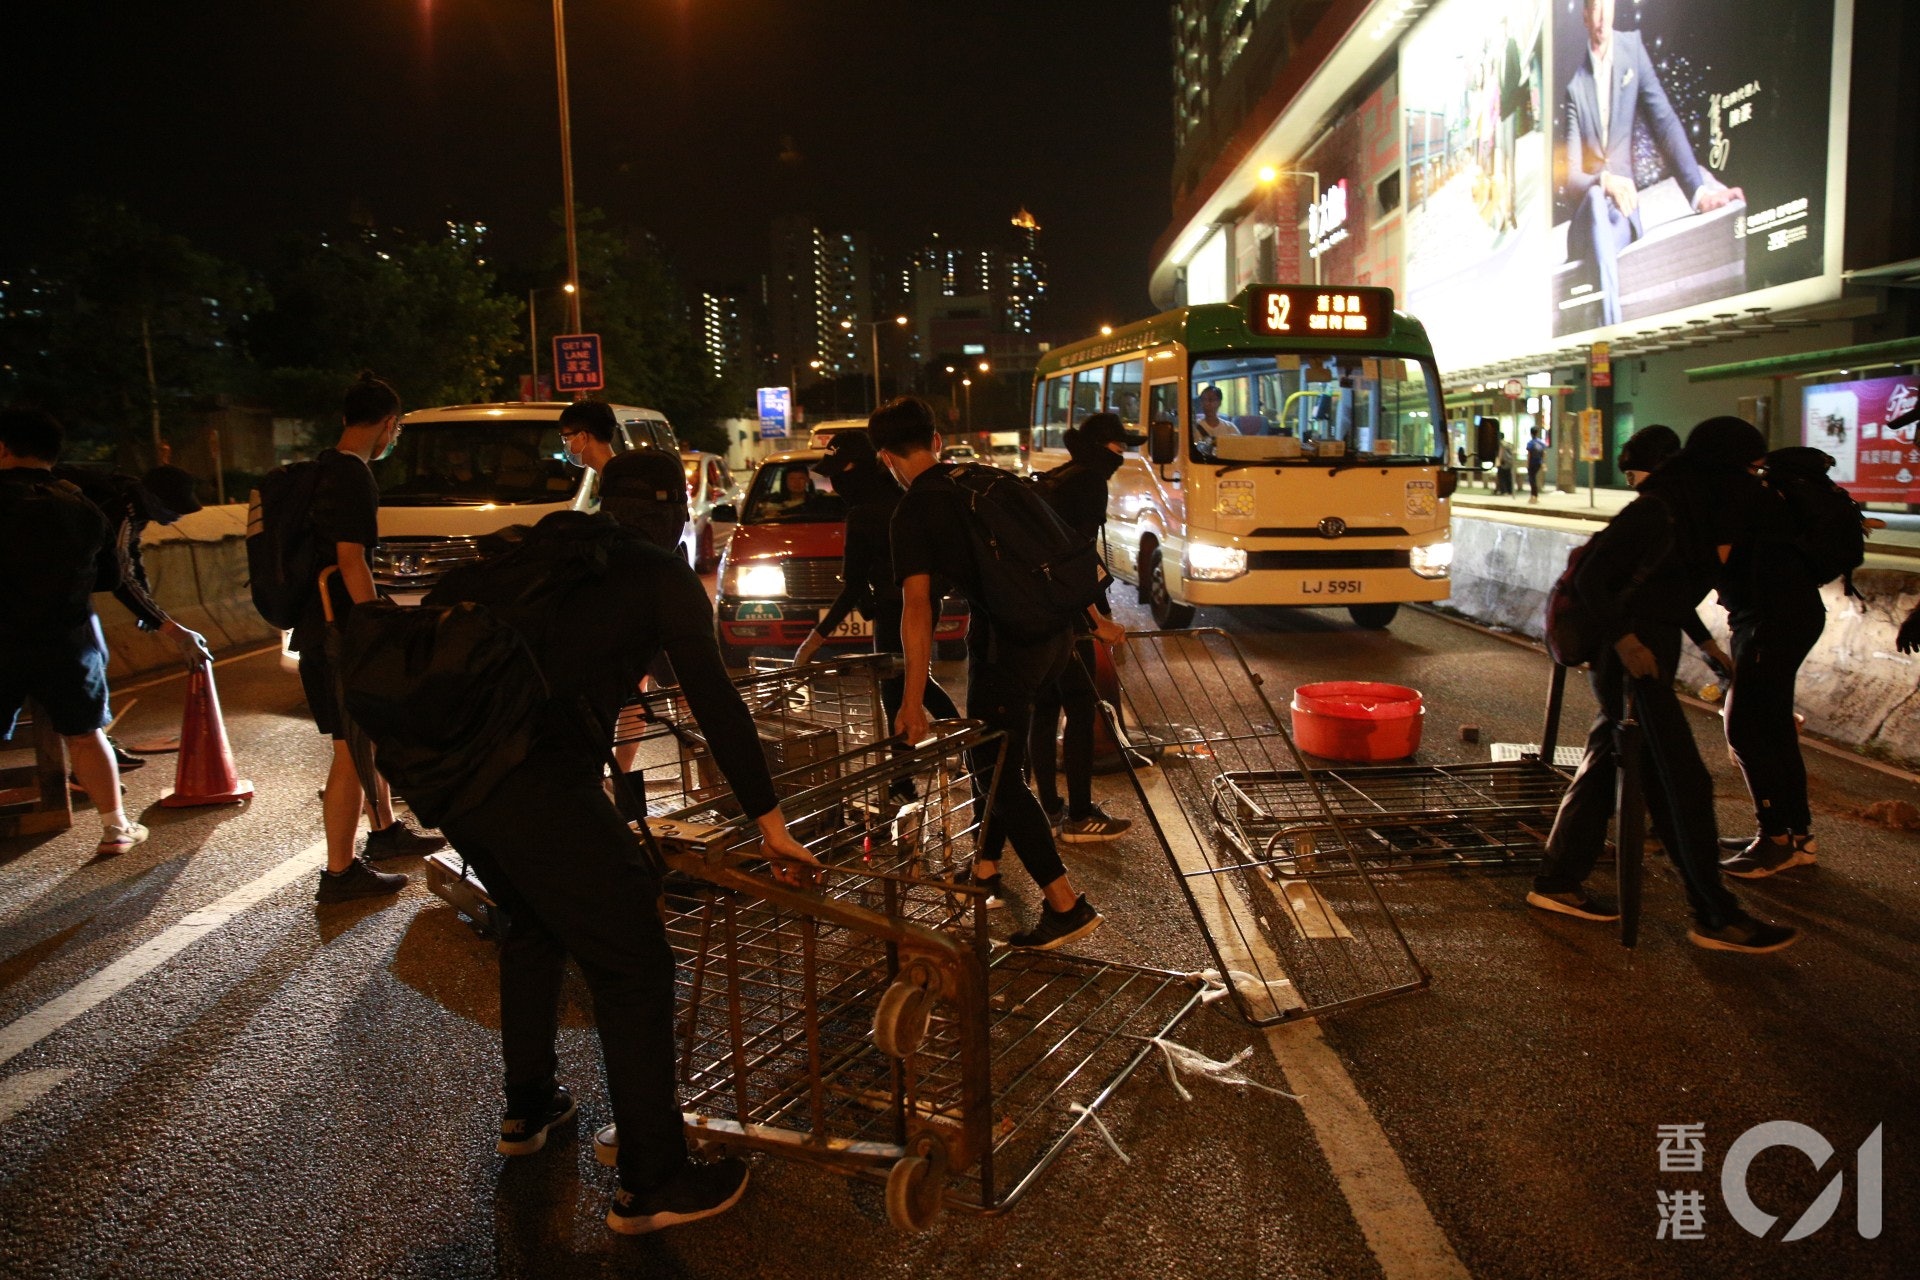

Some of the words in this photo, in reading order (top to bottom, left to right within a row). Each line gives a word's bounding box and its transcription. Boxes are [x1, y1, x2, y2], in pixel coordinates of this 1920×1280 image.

[1267, 294, 1290, 330] 52
[562, 342, 580, 350] GET
[582, 341, 592, 349] IN
[564, 350, 590, 360] LANE
[1302, 581, 1322, 594] LJ
[1328, 581, 1361, 593] 5951
[754, 604, 764, 613] 4
